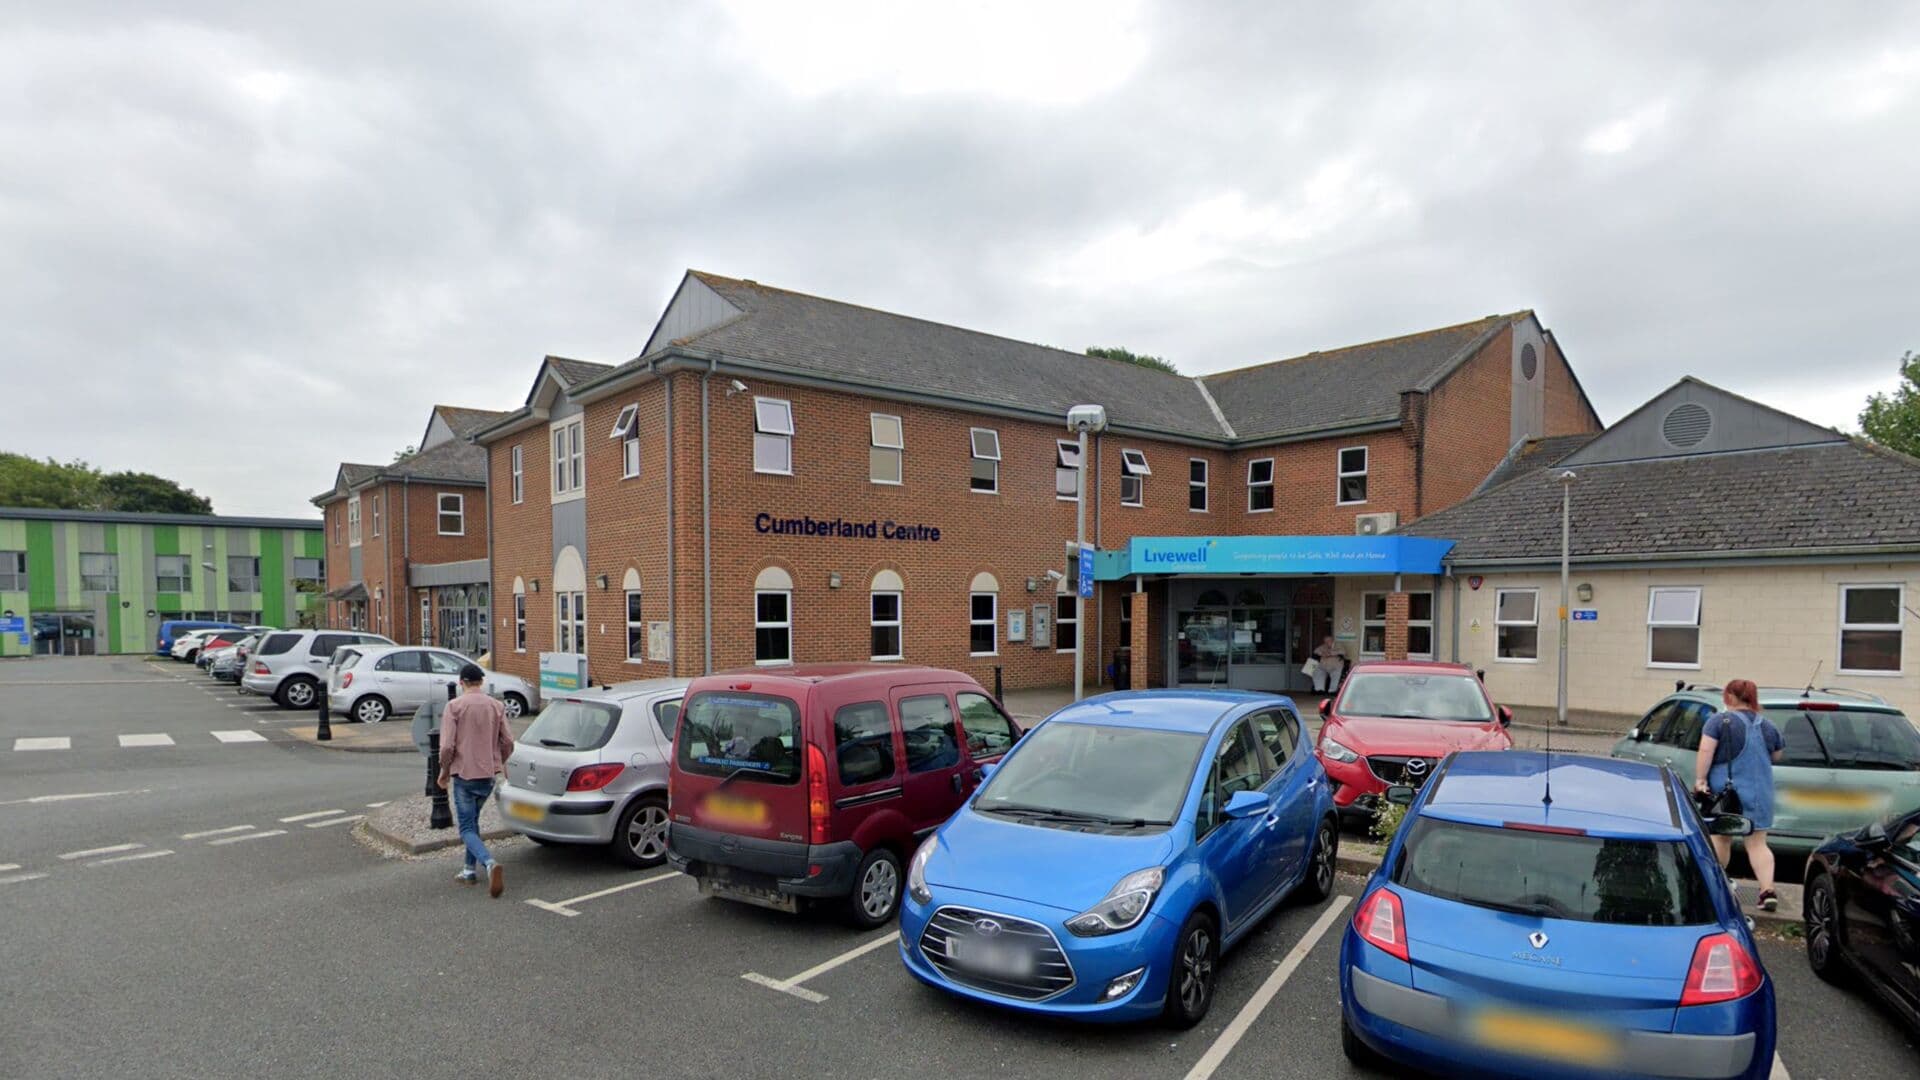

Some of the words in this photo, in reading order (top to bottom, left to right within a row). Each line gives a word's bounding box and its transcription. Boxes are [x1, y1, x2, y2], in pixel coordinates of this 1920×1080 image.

[755, 512, 877, 539] Cumberland
[882, 520, 941, 542] Centre
[1144, 547, 1207, 562] Livewell
